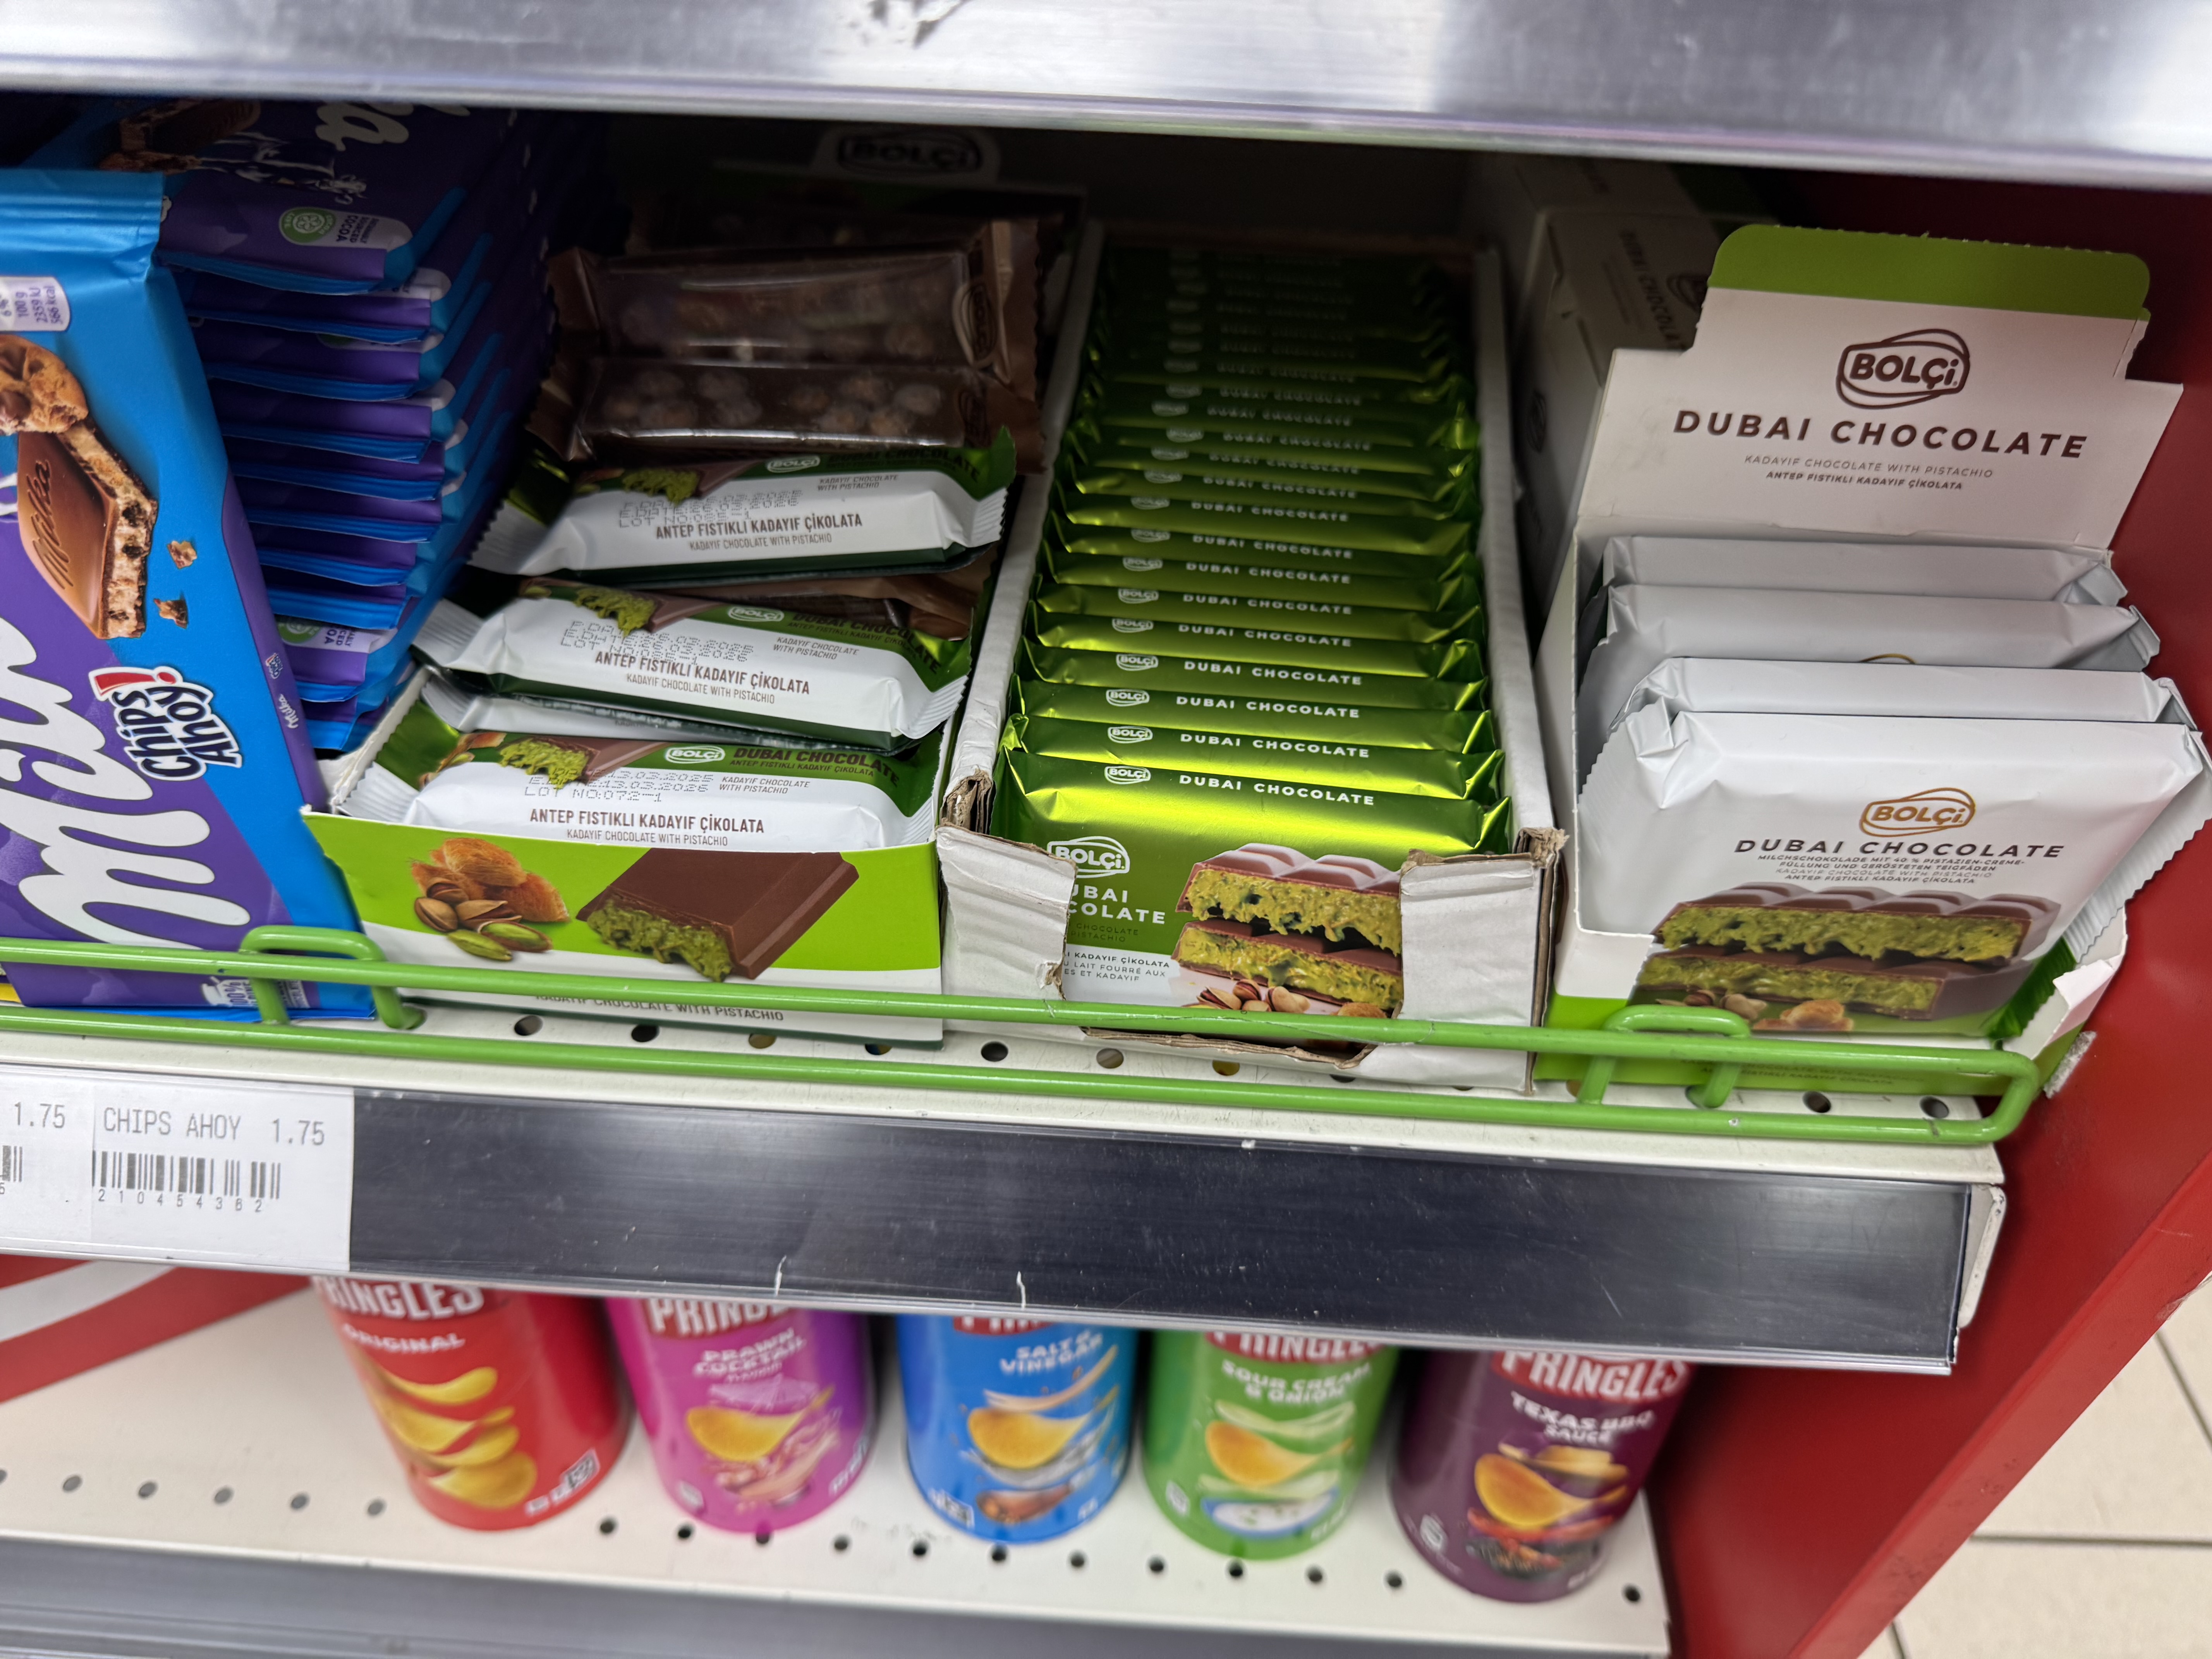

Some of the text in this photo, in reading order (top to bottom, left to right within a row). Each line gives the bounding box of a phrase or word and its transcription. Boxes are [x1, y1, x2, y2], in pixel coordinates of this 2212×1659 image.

[1673, 410, 2087, 459] DUBAI CHOCOLATE
[1744, 455, 1993, 478] KADAYIF CHOCOLATE WITH PISTACHIO
[838, 482, 879, 491] PISTACHIO
[853, 474, 899, 483] CHOCOLATE
[1766, 471, 1803, 480] ANTEP
[1807, 473, 1852, 483] FISTIKLI
[1856, 476, 1905, 486] KADAYIF
[656, 526, 694, 539] ANTEP
[699, 521, 748, 537] FISTIKLI
[751, 517, 800, 532] KADAYIF
[690, 533, 833, 551] KADAYIF CHOCOLATE WITH PISTACHIO
[1193, 535, 1353, 559] DUBAI CHOCOLATE
[1186, 562, 1351, 584] DUBAI CHOCOLATE
[1183, 594, 1352, 615] DUBAI CHOCOLATE
[777, 636, 860, 656] KADAYIF CHOCOLATE
[1178, 624, 1352, 647] DUBAI CHOCOLATE
[773, 644, 838, 660] WITH PISTACHIO
[595, 651, 810, 695] ANTEP FISTIKLI KADAYIF ÇİKOLATA
[1184, 661, 1361, 685] DUBAI CHOCOLATE
[627, 673, 775, 704] KADAYIF CHOCOLATE WITH PISTACHIO
[1176, 696, 1360, 718] DUBAI CHOCOLATE
[1180, 733, 1369, 758] DUBAI CHOCOLATE
[733, 747, 899, 788] DUBAI CHOCOLATE
[760, 761, 795, 769] FISTIKLI
[797, 763, 833, 772] KADAYIF
[524, 787, 558, 797] LOT
[719, 783, 788, 794] WITH PISTACHIO
[759, 778, 811, 788] CHOCOLATE
[1180, 775, 1374, 805] DUBAI CHOCOLATE
[530, 809, 765, 834] ANTEP FISTIKLI KADAYIF ÇİKOLATA
[567, 829, 728, 847] KADAYIF CHOCOLATE WITH PISTACHIO
[1734, 839, 2064, 858] DUBAI CHOCOLATE
[1758, 855, 1867, 863] MILCHSCHOKOLADE
[1072, 884, 1128, 903] BAI
[1069, 900, 1165, 925] COLATE
[1070, 931, 1126, 943] PISTACHIO
[1076, 923, 1139, 936] CHOCOLATE
[1074, 962, 1096, 970] LAIT
[1100, 963, 1141, 974] FOURRÉ
[1145, 969, 1165, 977] AUX
[1075, 952, 1117, 962] KADAYIF
[1121, 956, 1170, 968] ÇİKOLATA
[1096, 972, 1139, 981] KADAYIF
[677, 1003, 711, 1015] WITH
[715, 1007, 784, 1021] PISTACHIO
[14, 1101, 66, 1128] 1.75
[103, 1106, 325, 1146] CHIPS AHOY 1.75
[312, 1277, 485, 1320] RINGLES
[342, 1323, 466, 1353] ORIGINAL
[1221, 1358, 1287, 1393] SOUR
